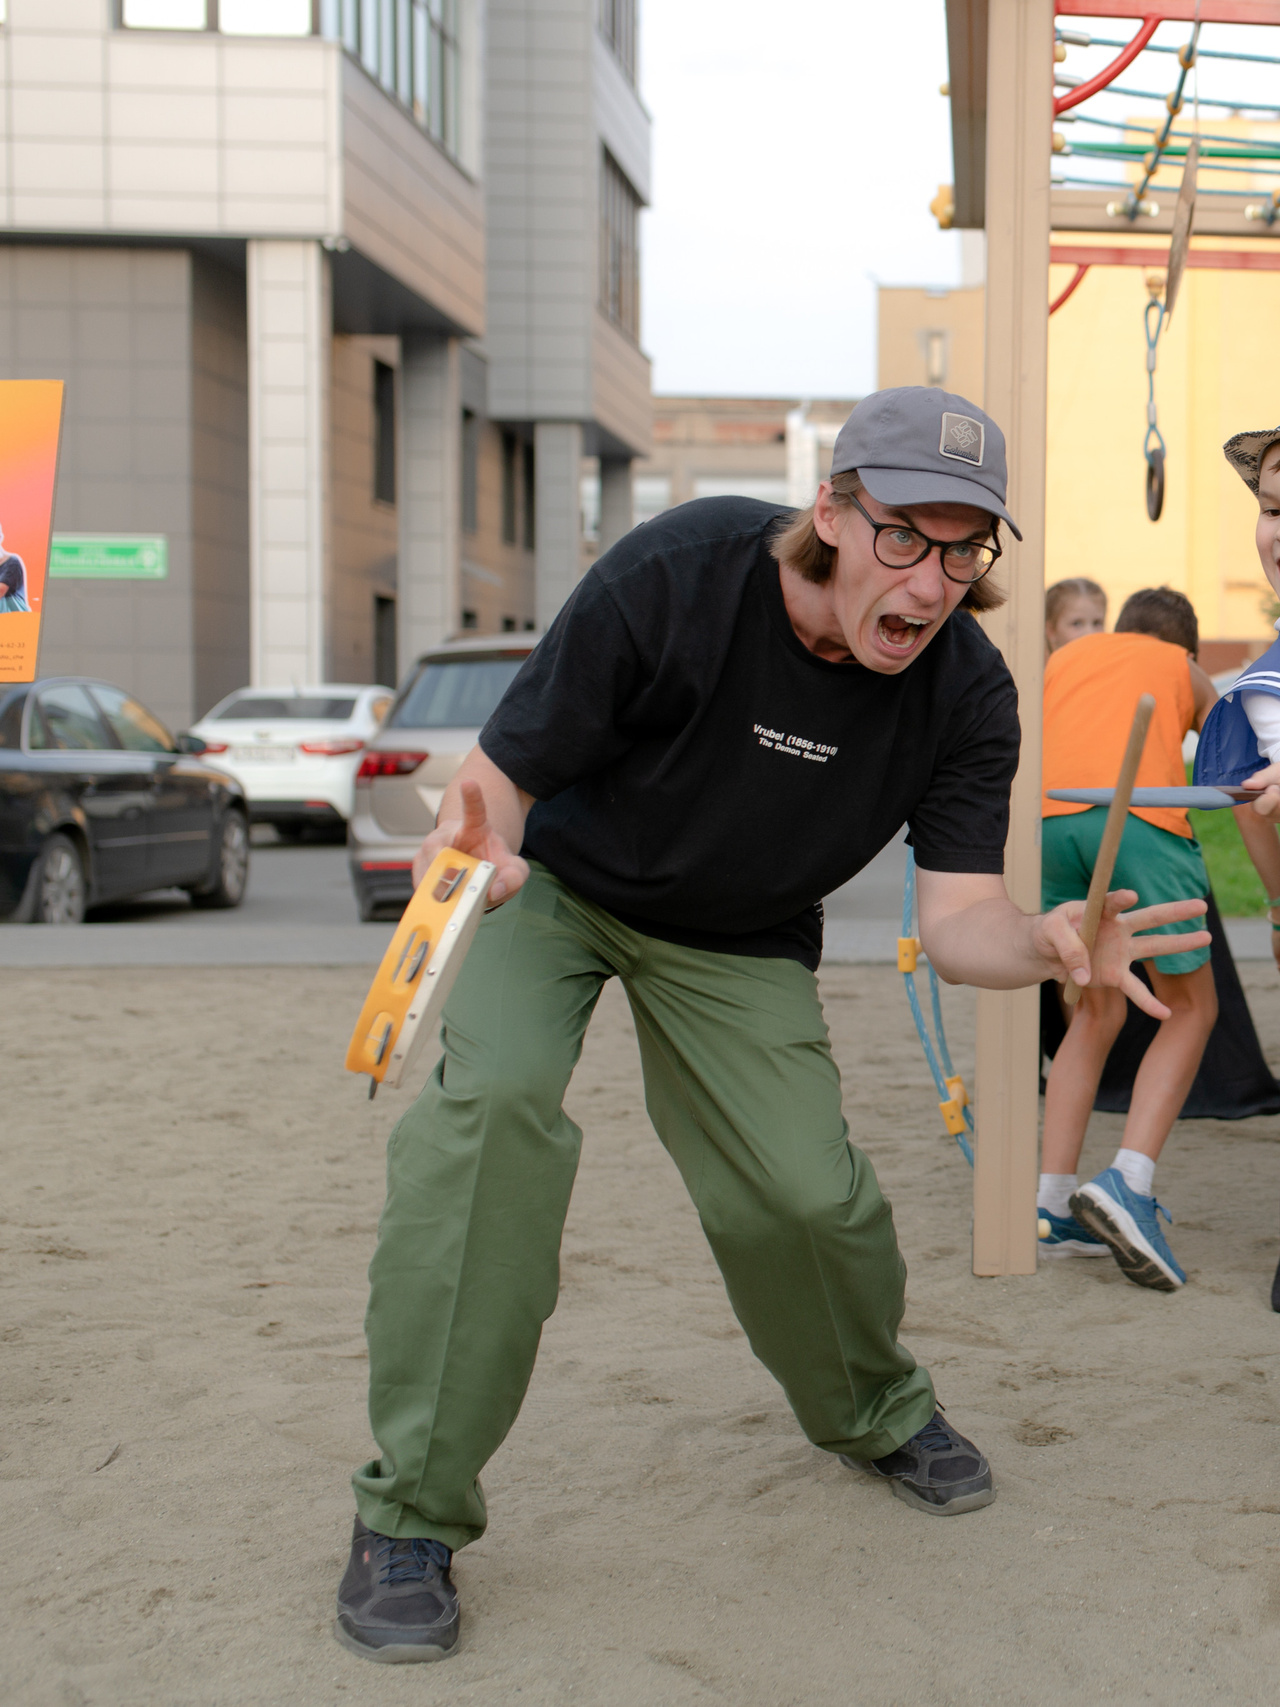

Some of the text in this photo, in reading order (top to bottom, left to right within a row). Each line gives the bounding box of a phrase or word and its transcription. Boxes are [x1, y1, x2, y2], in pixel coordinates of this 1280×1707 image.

[753, 723, 785, 741] Vrubel
[759, 737, 828, 763] The Demon Seated
